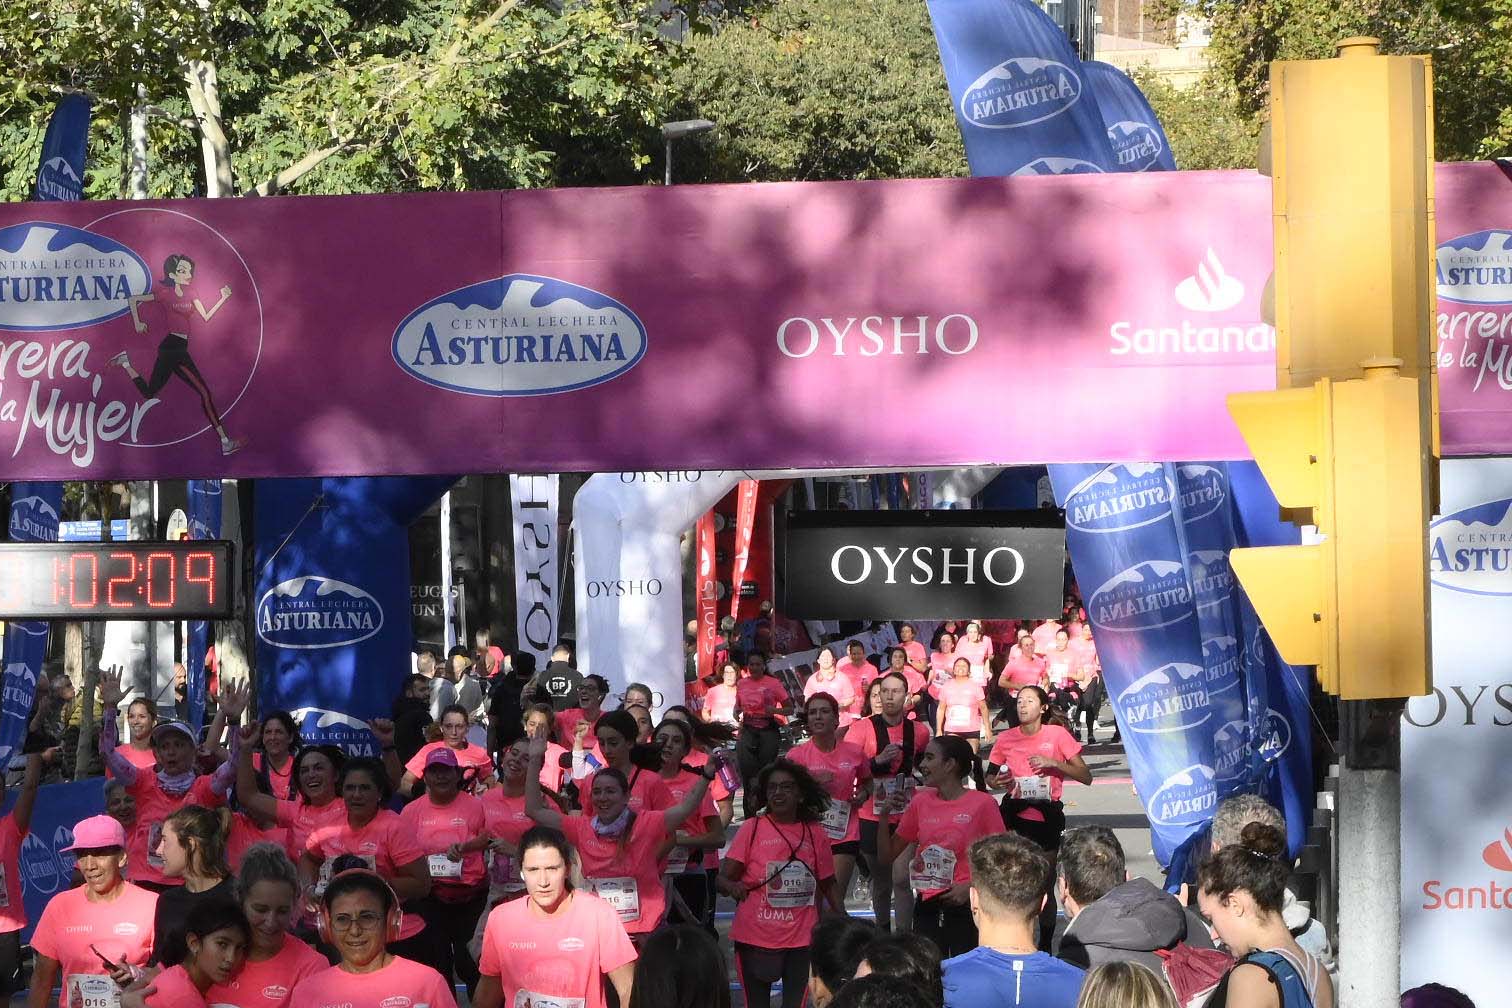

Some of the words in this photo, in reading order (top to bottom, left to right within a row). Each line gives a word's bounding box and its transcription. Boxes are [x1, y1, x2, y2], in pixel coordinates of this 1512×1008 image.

[54, 258, 126, 270] LECHERA
[1450, 254, 1502, 264] CENTRAL
[451, 317, 530, 331] CENTRAL
[538, 314, 619, 329] LECHERA
[1436, 310, 1512, 340] arrer
[411, 321, 628, 366] ASTURIANA
[776, 313, 980, 359] OYSHO
[1459, 340, 1477, 368] la
[11, 373, 161, 468] Mujer
[519, 472, 553, 651] OYSH
[830, 545, 1025, 588] OYSHO
[586, 578, 663, 599] OYSHO
[261, 604, 375, 633] ASTURIANA
[546, 681, 568, 691] BP
[783, 878, 801, 887] 016
[758, 907, 795, 922] SUMA
[84, 998, 107, 1008] 016
